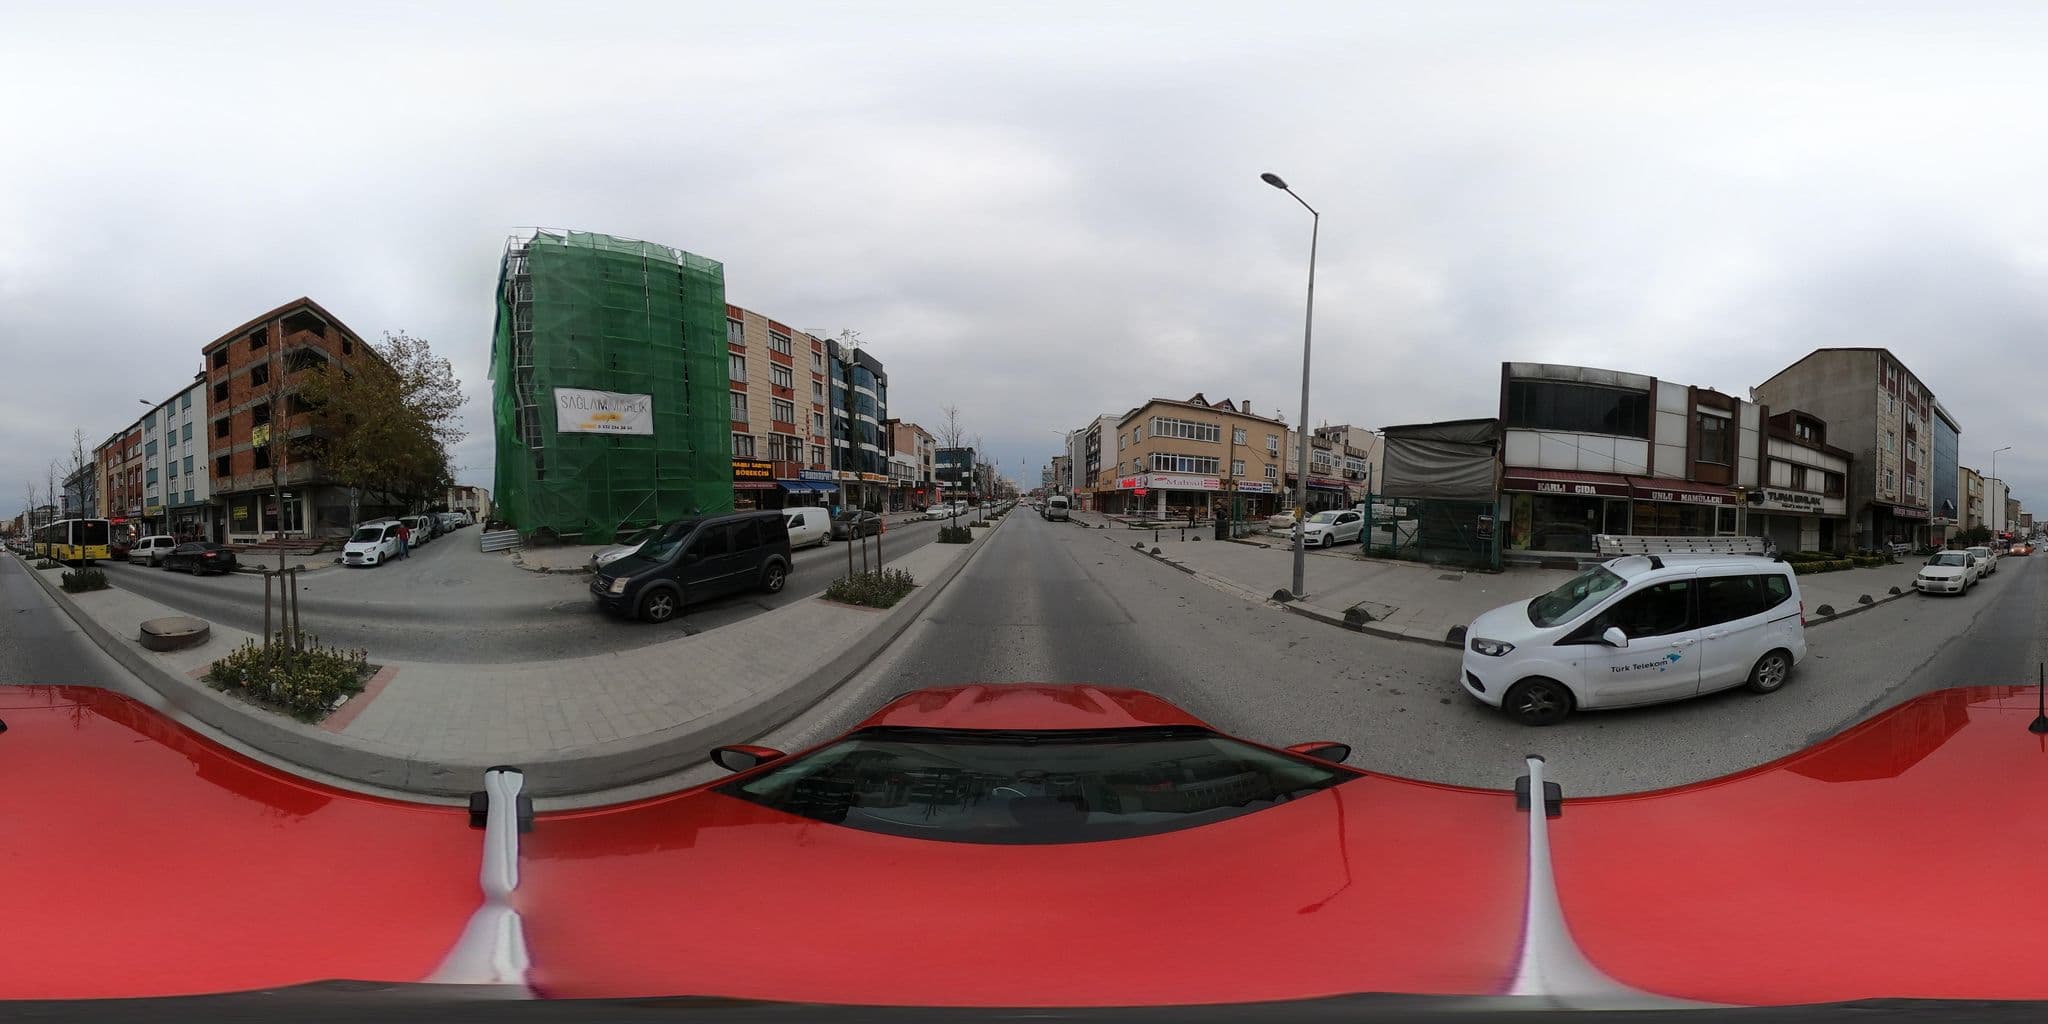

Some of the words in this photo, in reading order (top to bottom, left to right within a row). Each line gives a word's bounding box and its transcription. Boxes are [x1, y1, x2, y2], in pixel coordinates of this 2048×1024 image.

[1537, 482, 1566, 492] KARLI
[1575, 485, 1597, 494] GIDA
[1611, 665, 1630, 673] Türk
[1633, 660, 1668, 670] Telekom
